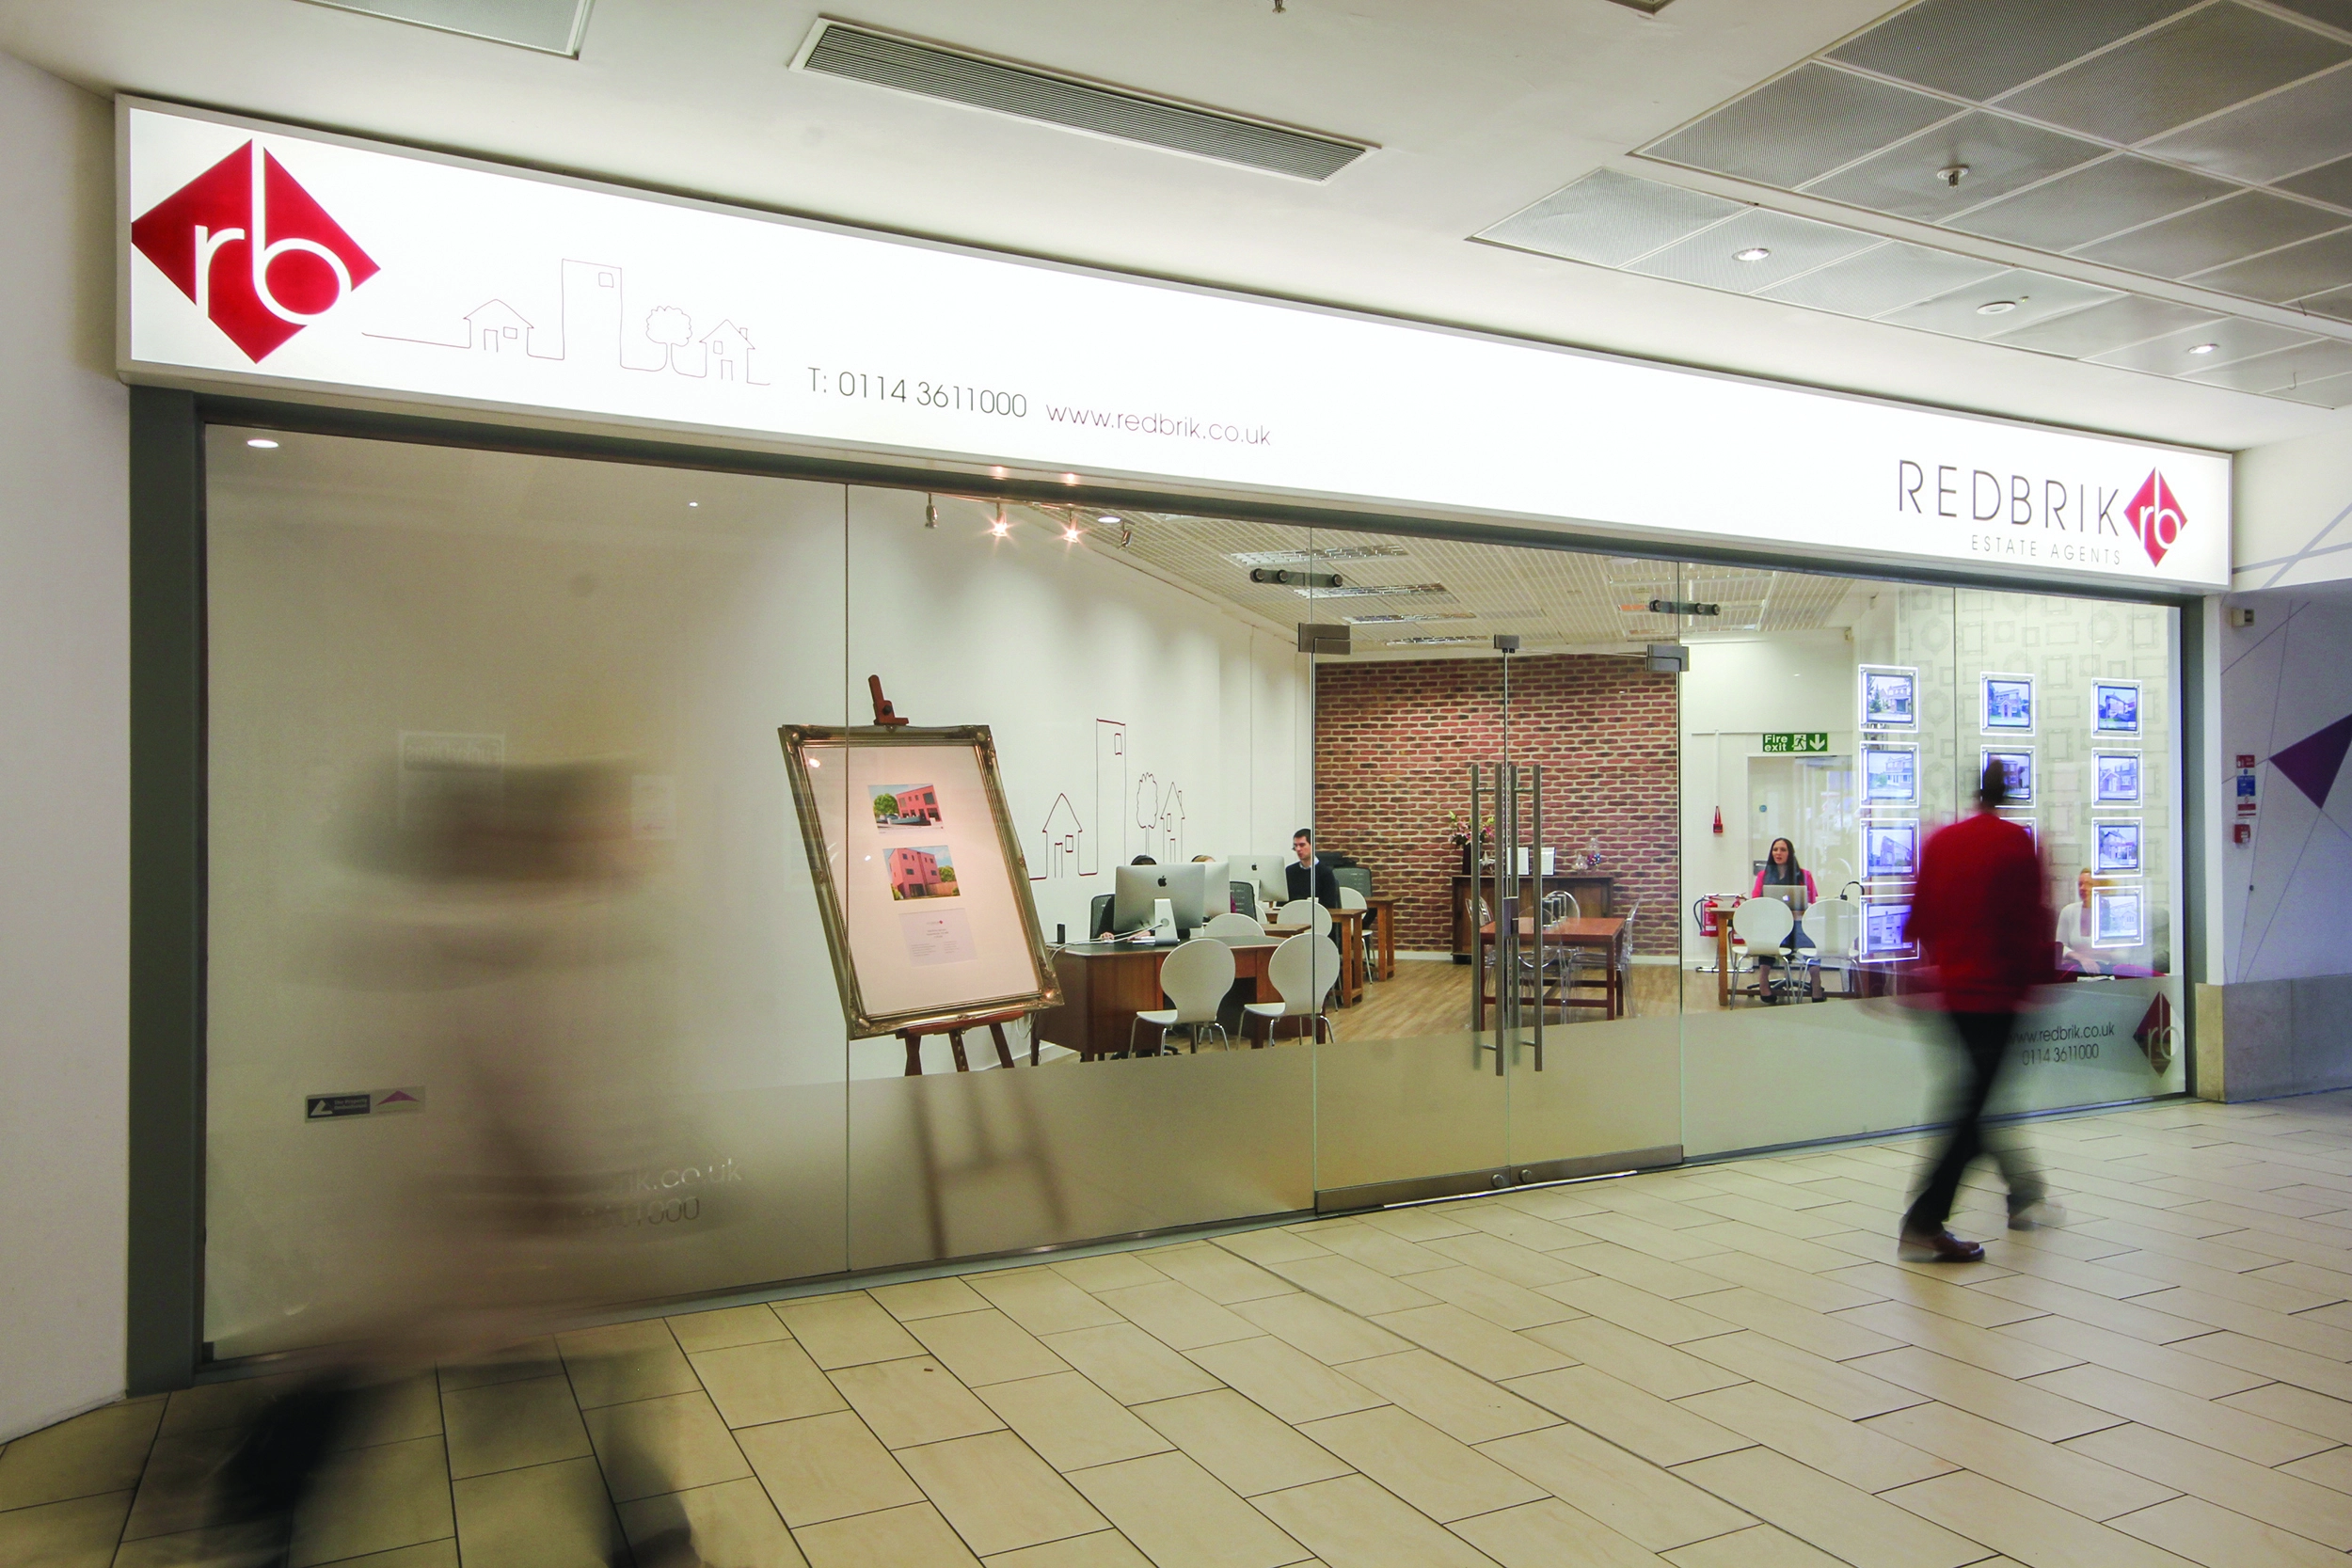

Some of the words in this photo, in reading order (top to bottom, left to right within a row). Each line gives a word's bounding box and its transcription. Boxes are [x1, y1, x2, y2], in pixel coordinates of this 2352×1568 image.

[195, 140, 352, 325] rb
[807, 367, 828, 393] T:
[838, 372, 907, 404] 0114
[915, 380, 1027, 418] 3611000
[1045, 403, 1271, 446] www.redbrik.co.uk
[1899, 459, 2120, 537] REDBRIK
[1971, 534, 2038, 557] ESTATE
[2050, 543, 2122, 565] AGENTS
[1764, 742, 1788, 752] exit
[1765, 734, 1788, 743] Fire
[2022, 1048, 2050, 1066] 0114
[2054, 1043, 2099, 1063] 3611000
